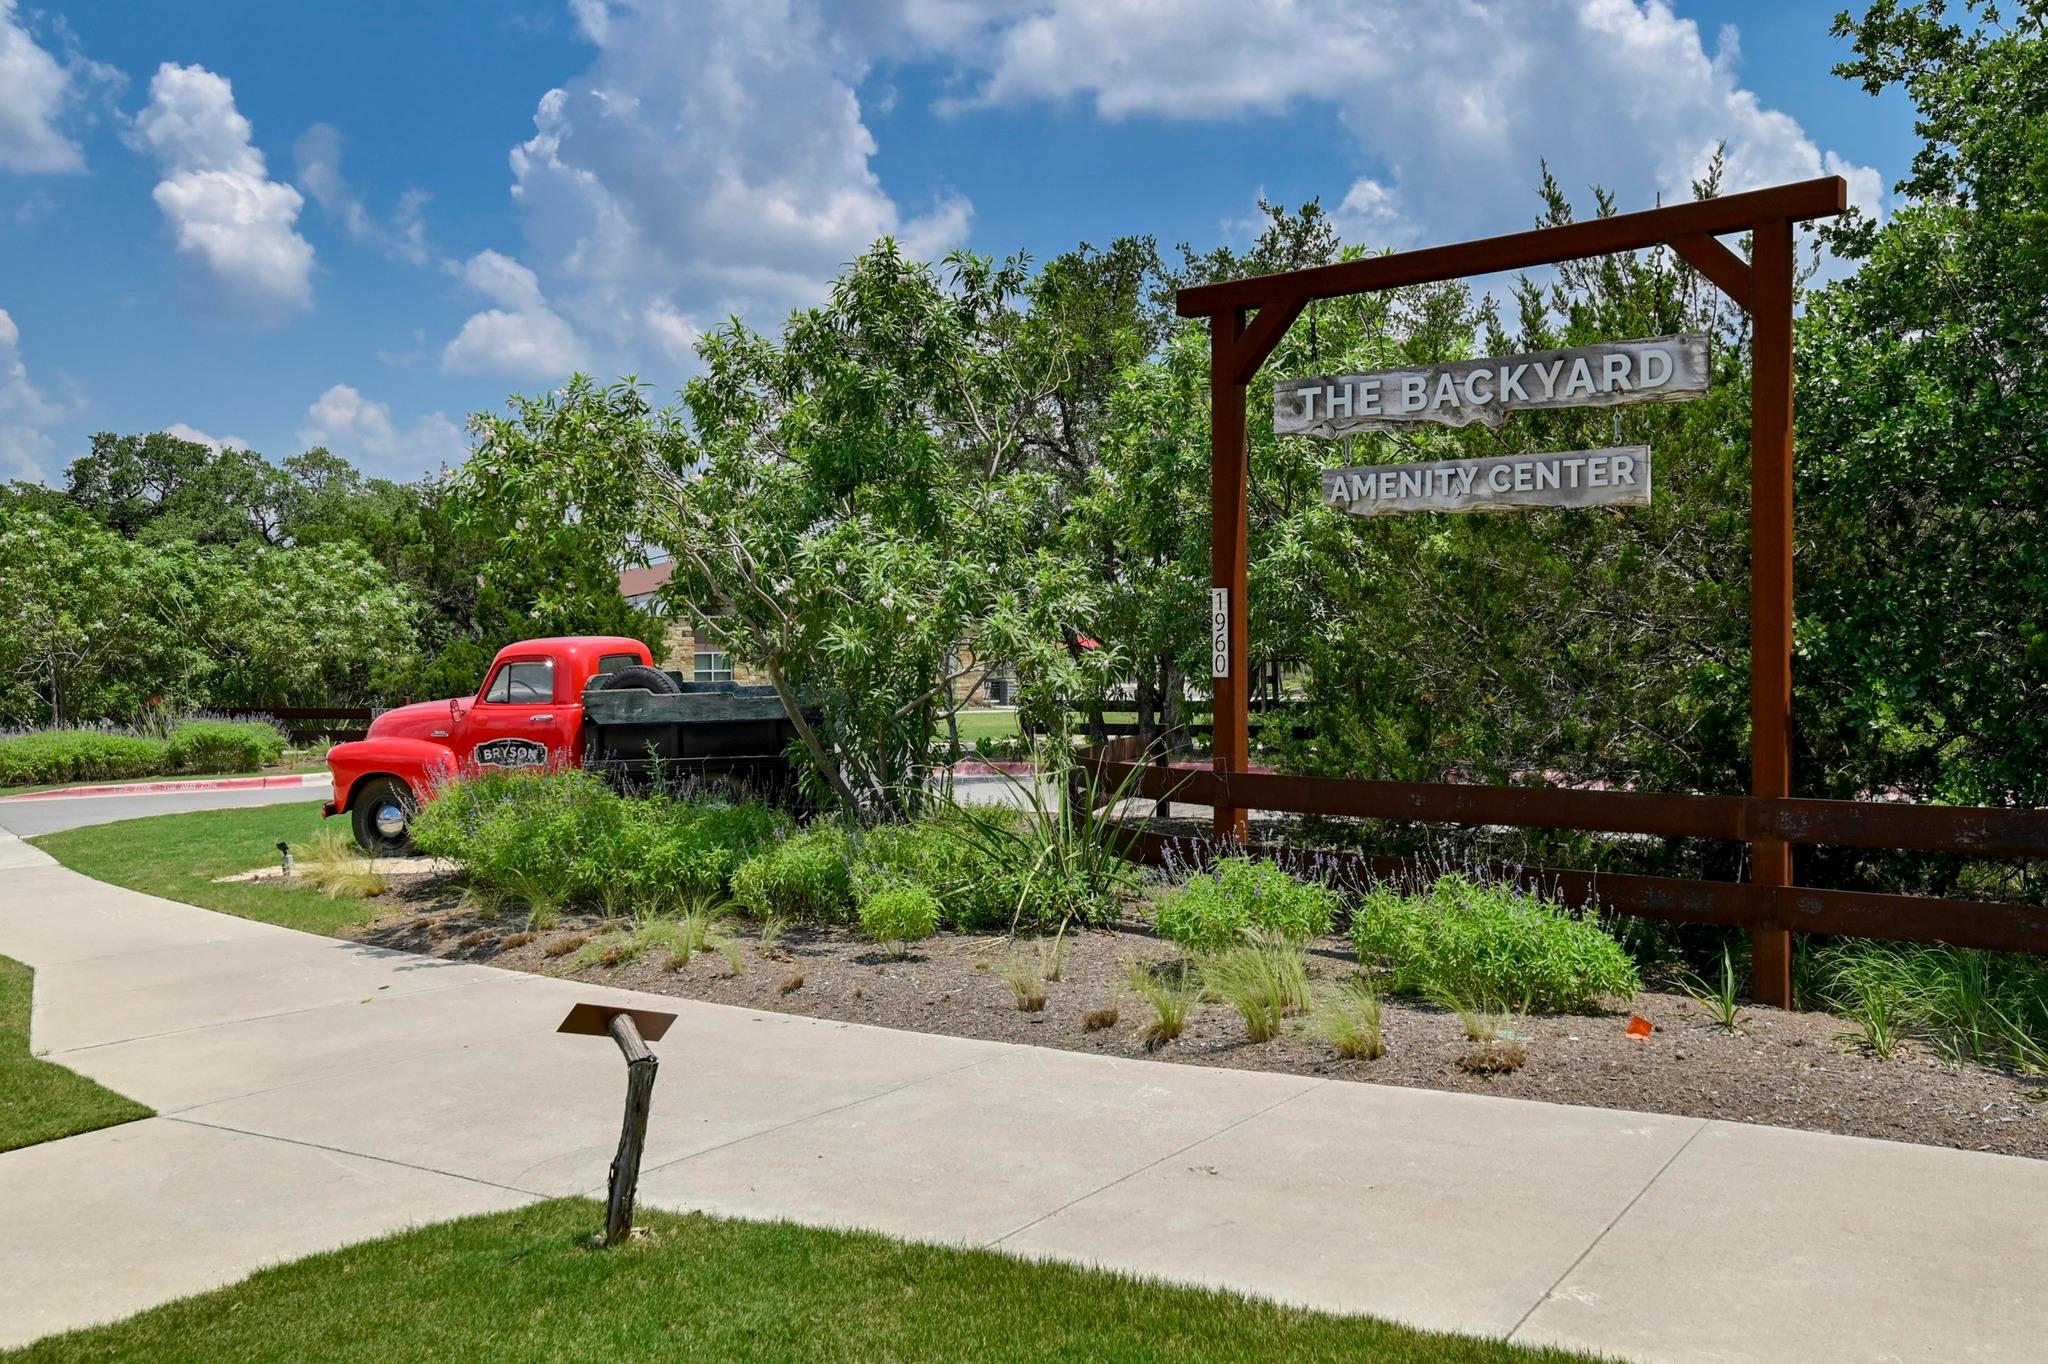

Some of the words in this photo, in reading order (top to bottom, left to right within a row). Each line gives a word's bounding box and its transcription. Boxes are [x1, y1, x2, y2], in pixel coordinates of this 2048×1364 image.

[1297, 381, 1384, 421] THE
[1402, 349, 1675, 413] BACKYARD
[1330, 465, 1480, 504] AMENITY
[1488, 455, 1637, 493] CENTER
[1215, 593, 1225, 672] 1960
[483, 746, 539, 760] BRYSON
